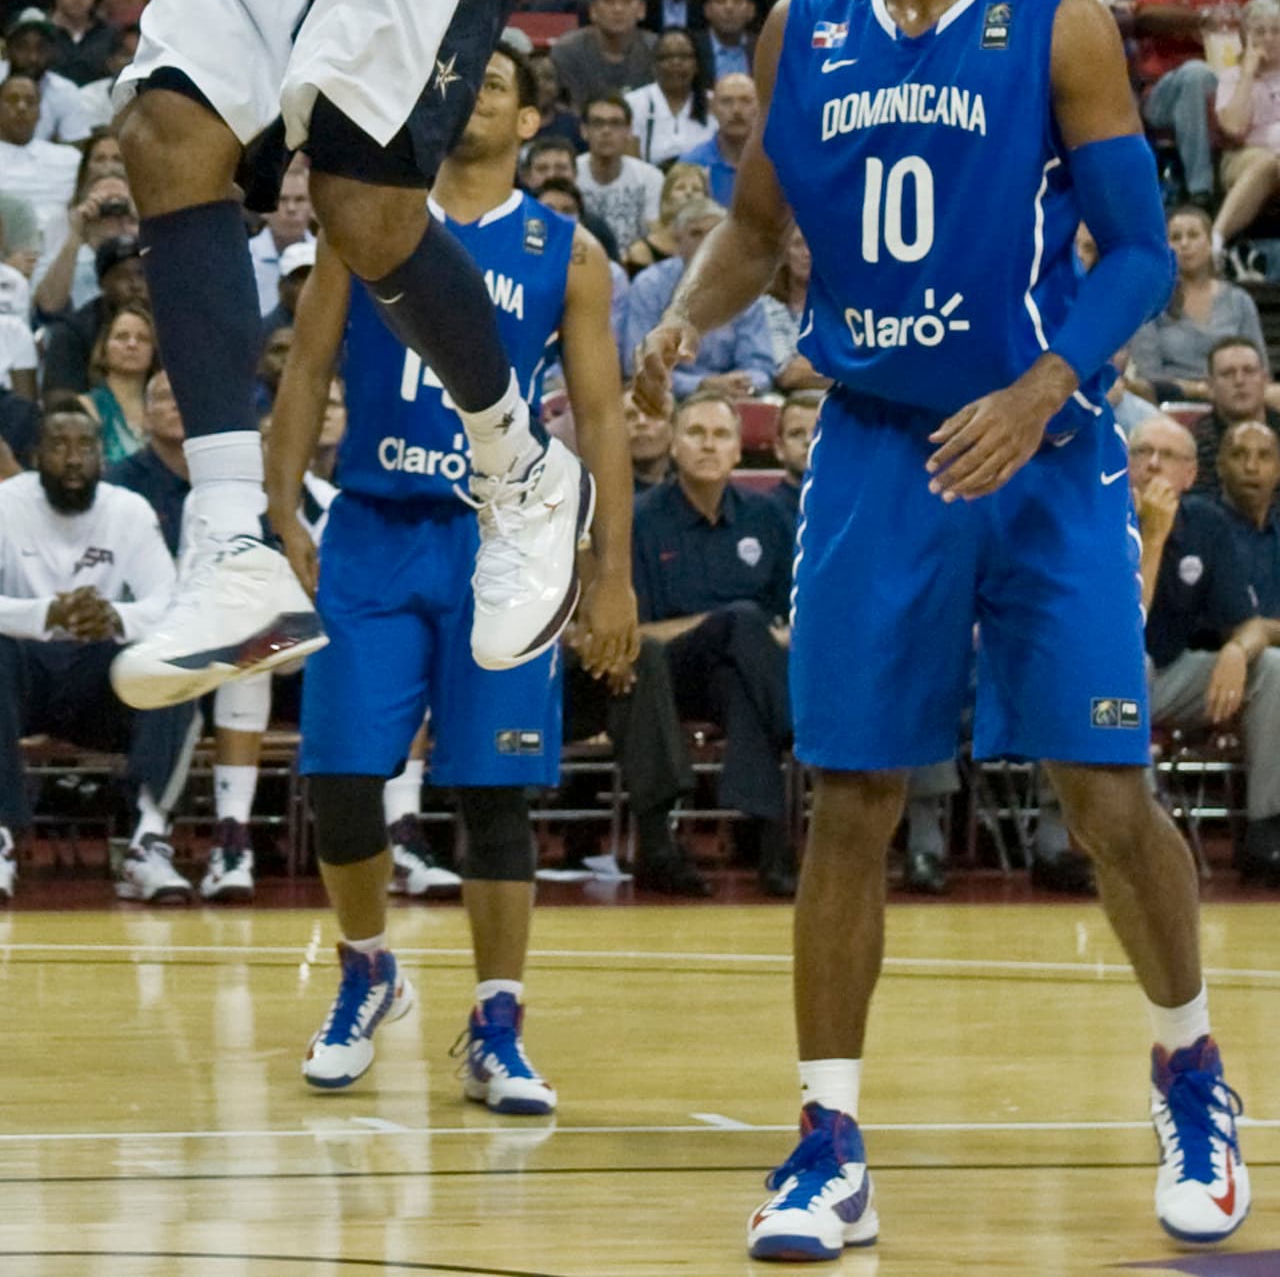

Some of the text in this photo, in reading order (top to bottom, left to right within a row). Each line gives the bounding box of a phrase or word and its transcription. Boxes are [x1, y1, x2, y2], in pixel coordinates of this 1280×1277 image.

[821, 83, 987, 142] DOMINICANA
[861, 155, 935, 264] 10
[844, 307, 946, 349] Claro
[377, 435, 467, 481] Claro
